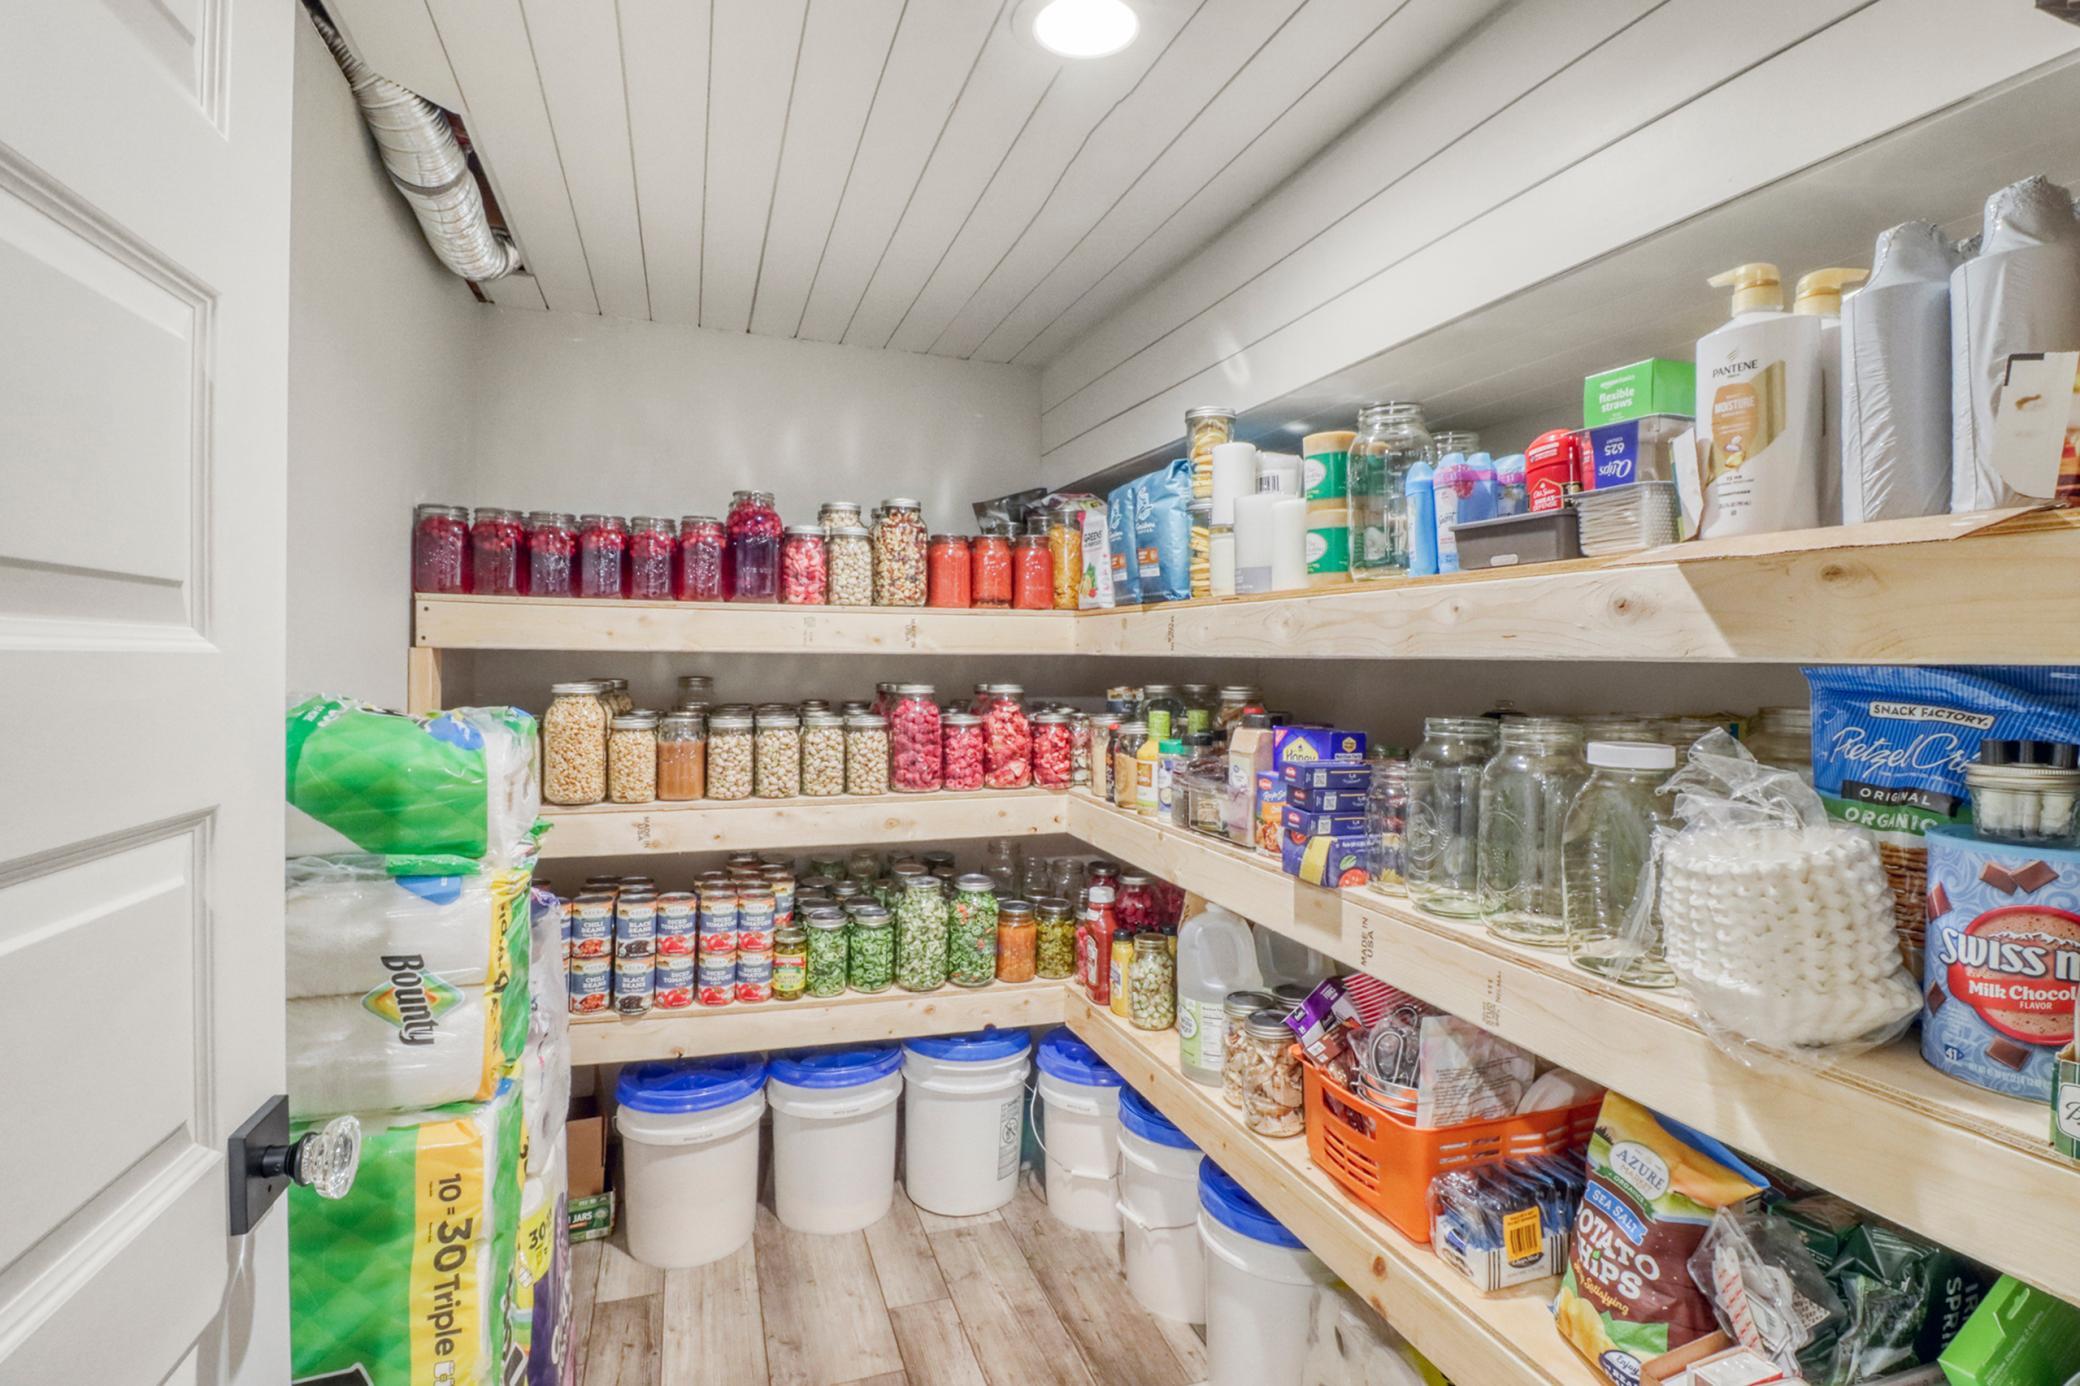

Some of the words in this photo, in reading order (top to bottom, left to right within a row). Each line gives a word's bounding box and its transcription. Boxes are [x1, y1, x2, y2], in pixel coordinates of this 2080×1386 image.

[1712, 359, 1758, 378] PANTENE
[1599, 387, 1634, 404] flexible
[1601, 399, 1632, 413] straws
[1604, 442, 1625, 456] 625
[1873, 704, 1916, 717] SNACK
[1844, 807, 1938, 831] ORGANIC
[1362, 916, 1368, 929] IN
[380, 954, 438, 1046] Bounty
[1968, 980, 2006, 999] Milk
[2009, 985, 2077, 1000] Chocol
[2020, 1001, 2052, 1010] FLAVOR
[1616, 1149, 1664, 1190] AZURE
[438, 1173, 462, 1202] 10
[573, 1211, 593, 1223] JARS
[1592, 1190, 1611, 1210] SEA
[1612, 1206, 1637, 1233] SALT
[433, 1217, 473, 1273] 30
[528, 1221, 546, 1250] 30
[427, 1273, 462, 1356] Triple
[1941, 1277, 1962, 1349] SPRI
